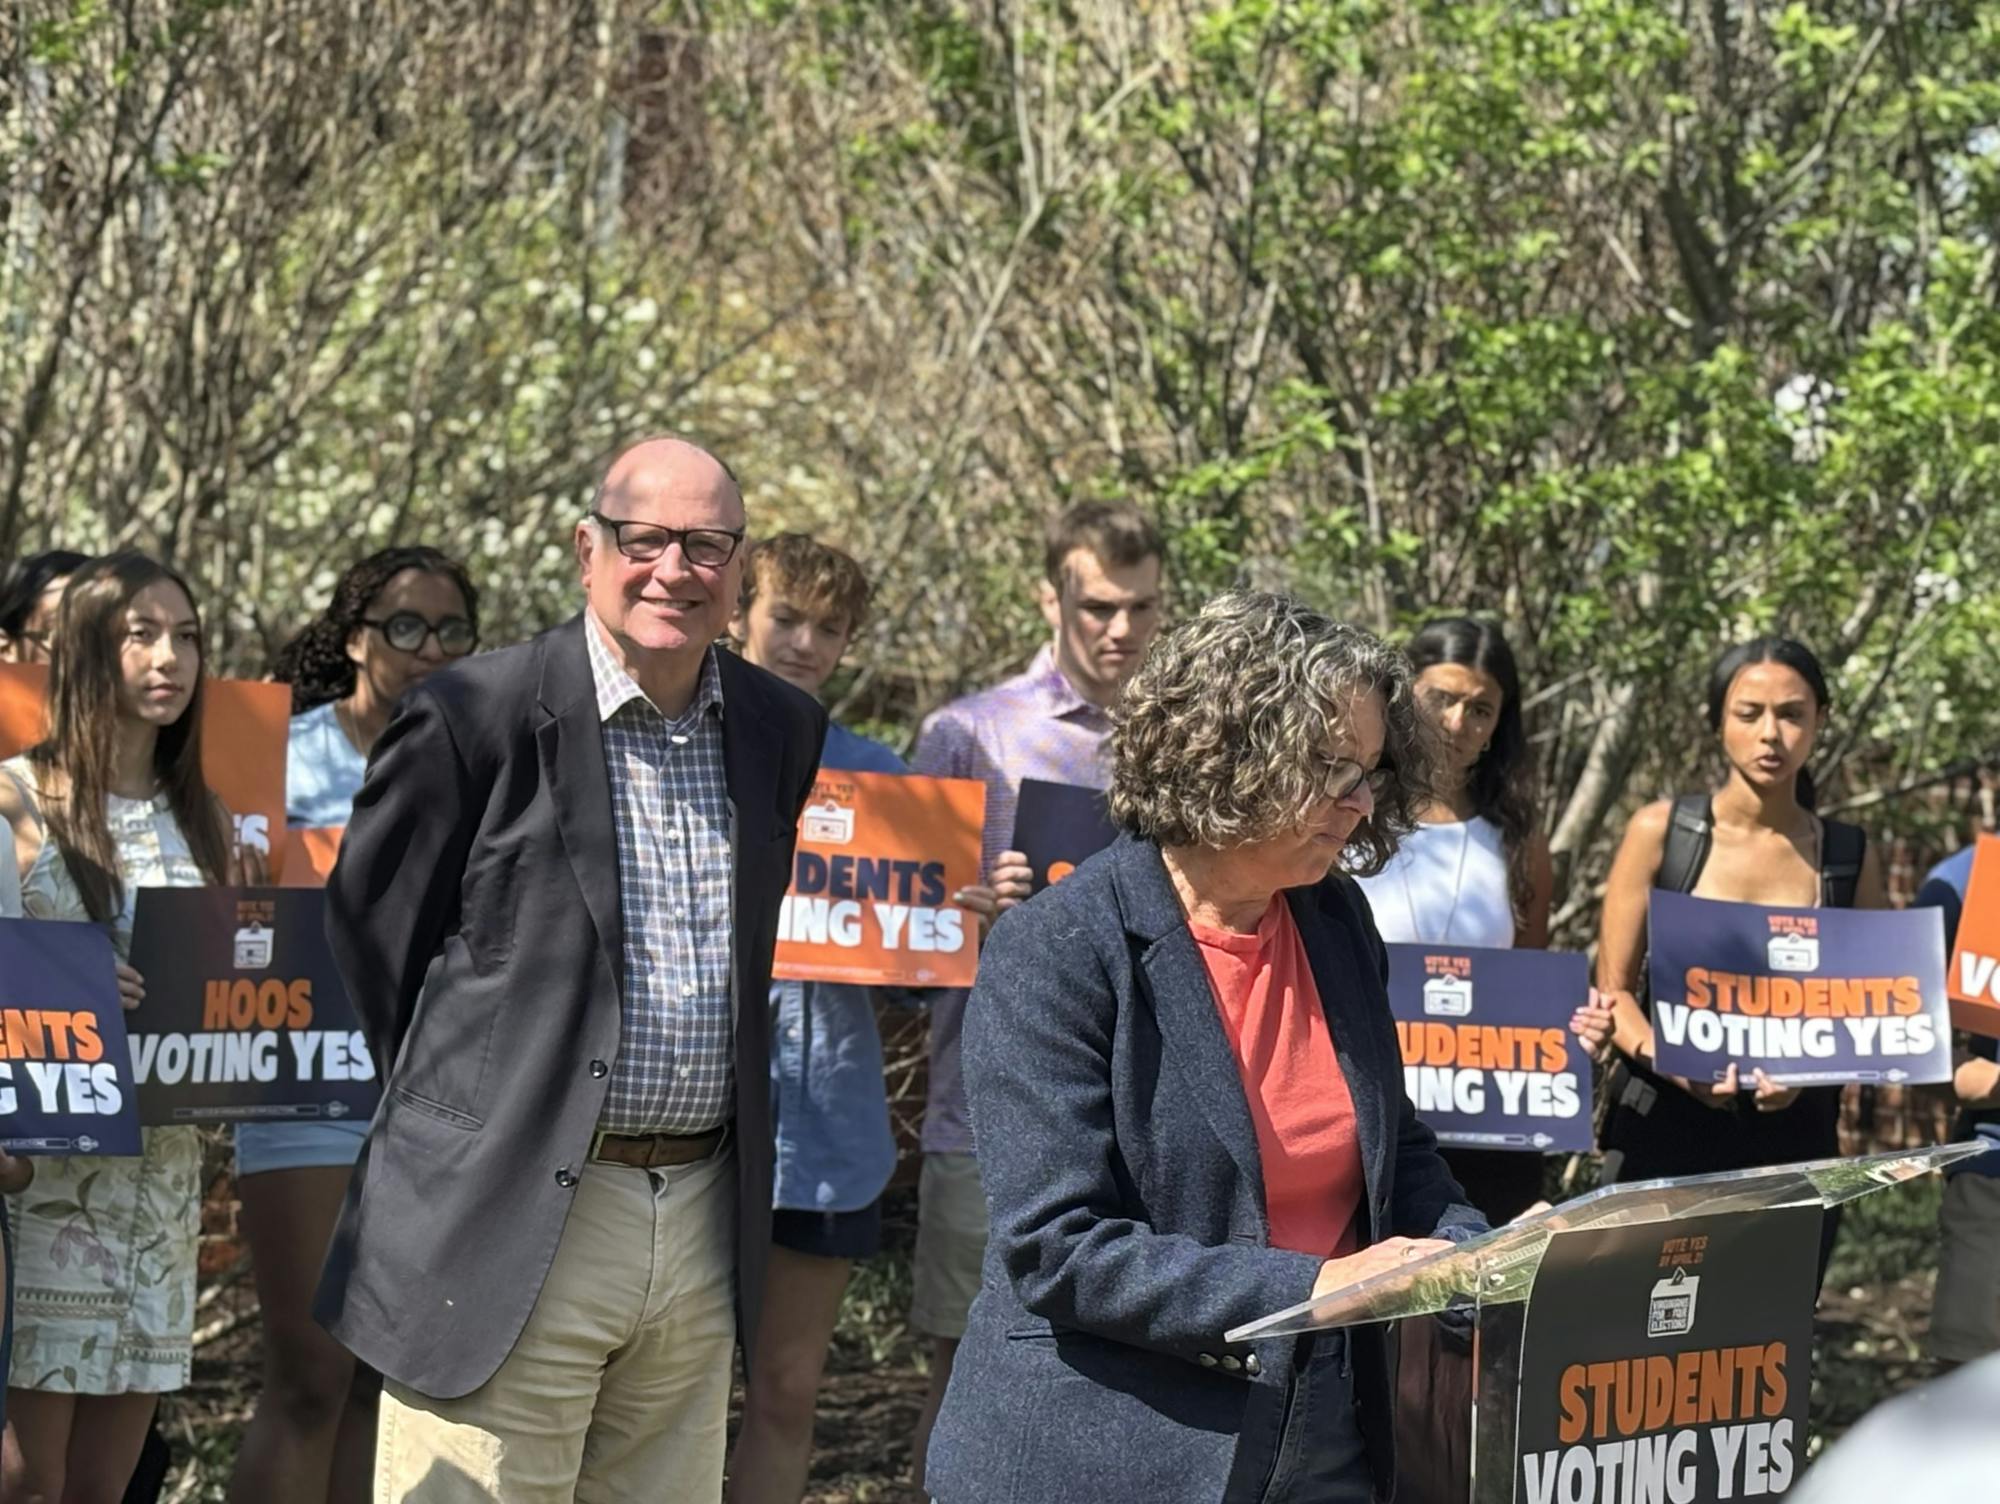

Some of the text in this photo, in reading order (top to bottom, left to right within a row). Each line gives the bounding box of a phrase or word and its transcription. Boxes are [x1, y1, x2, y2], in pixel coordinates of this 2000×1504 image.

[873, 903, 964, 953] YES
[203, 978, 313, 1030] HOOS
[1685, 967, 1923, 1018] STUDENTS
[1656, 1000, 1936, 1058] VOTING YES
[127, 1029, 376, 1085] VOTING YES
[25, 1062, 122, 1116] YES
[1493, 1070, 1580, 1118] YES
[1558, 1342, 1788, 1443] STUDENTS
[1523, 1418, 1794, 1504] VOTING YES
